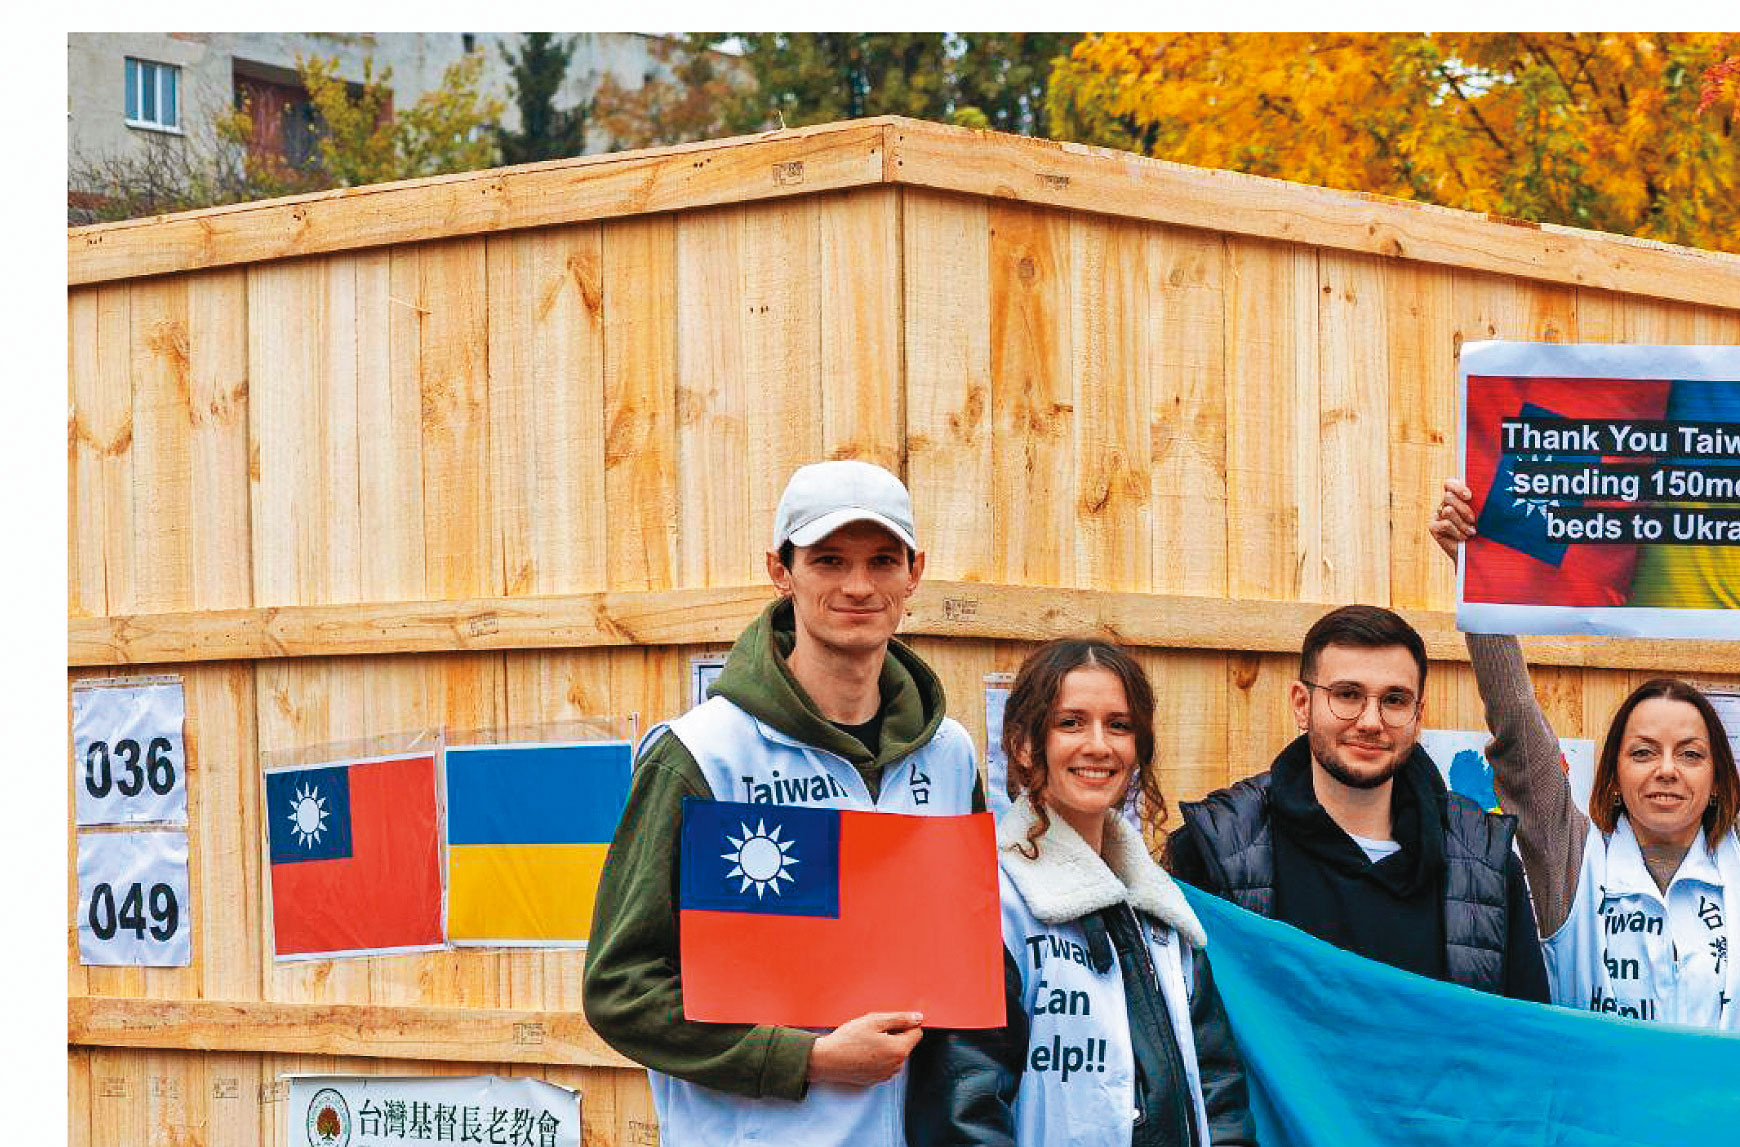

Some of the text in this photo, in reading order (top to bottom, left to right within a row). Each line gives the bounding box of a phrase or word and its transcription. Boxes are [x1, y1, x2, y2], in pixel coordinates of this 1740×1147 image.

[1502, 422, 1600, 452] Thank
[1609, 424, 1669, 453] You
[1513, 468, 1640, 501] sending
[1546, 513, 1622, 540] beds
[1632, 515, 1662, 540] to
[86, 737, 176, 798] 036
[88, 882, 179, 942] 049
[1025, 1034, 1107, 1083] elp!!
